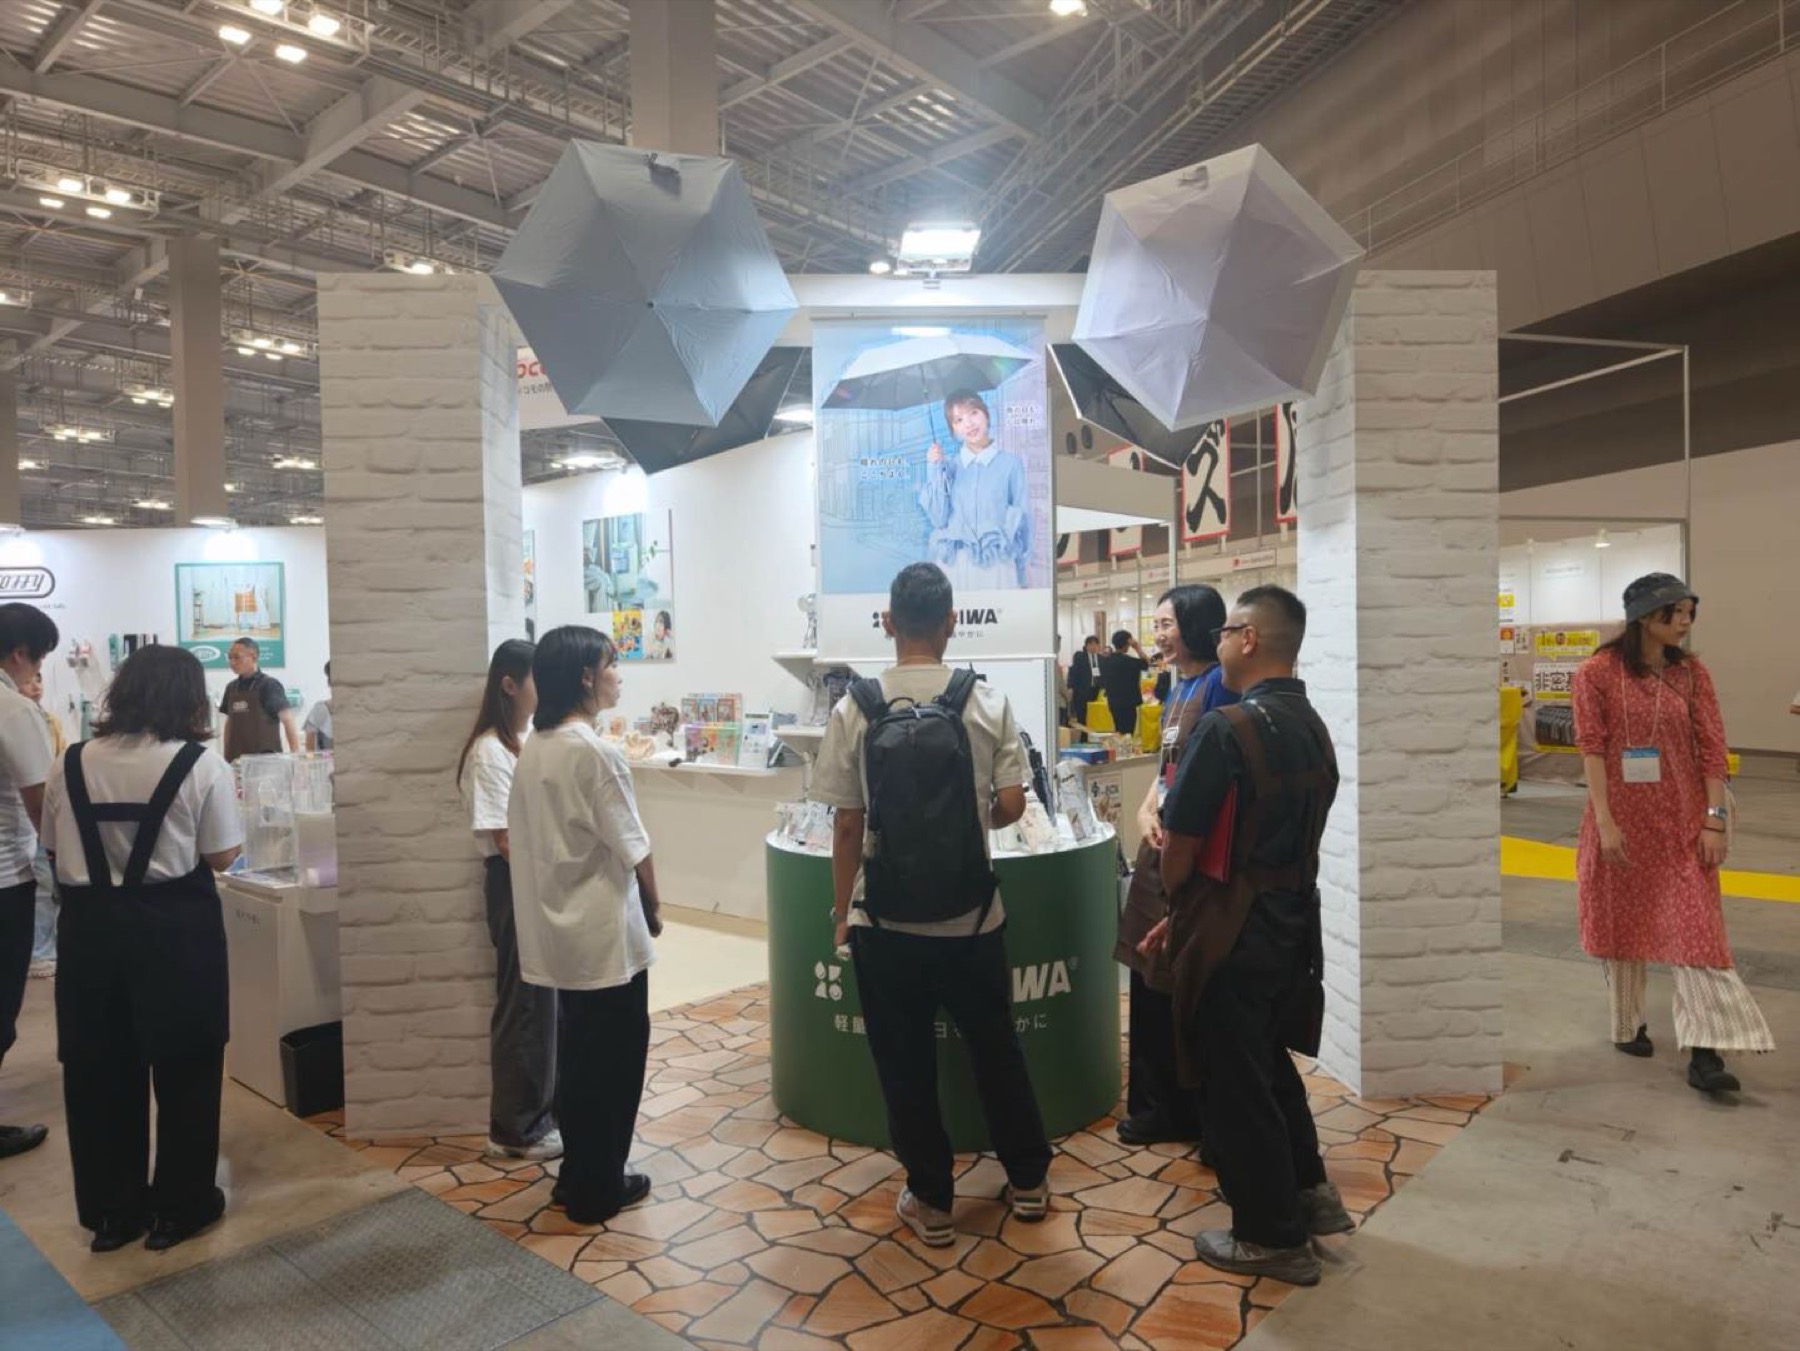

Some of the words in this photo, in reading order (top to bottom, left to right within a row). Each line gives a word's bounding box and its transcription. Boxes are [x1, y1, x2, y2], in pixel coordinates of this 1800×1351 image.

[957, 608, 998, 625] IWA
[1012, 960, 1072, 1003] WA
[1015, 1012, 1048, 1033] かに
